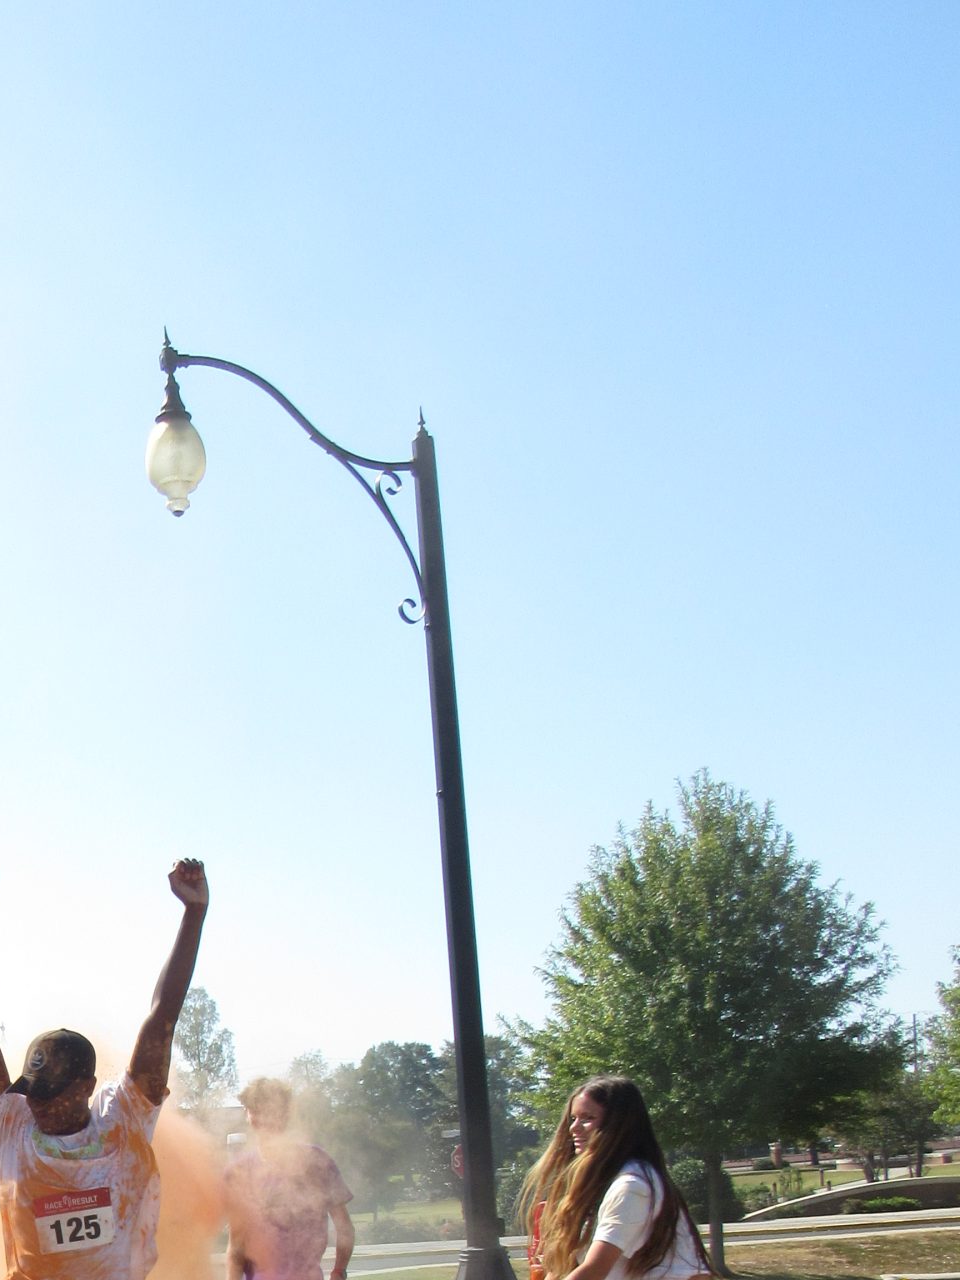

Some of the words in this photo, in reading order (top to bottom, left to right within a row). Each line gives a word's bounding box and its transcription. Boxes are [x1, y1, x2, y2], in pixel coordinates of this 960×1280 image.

[44, 1200, 63, 1210] RACE
[71, 1195, 98, 1206] RESULT
[50, 1214, 100, 1244] 125
